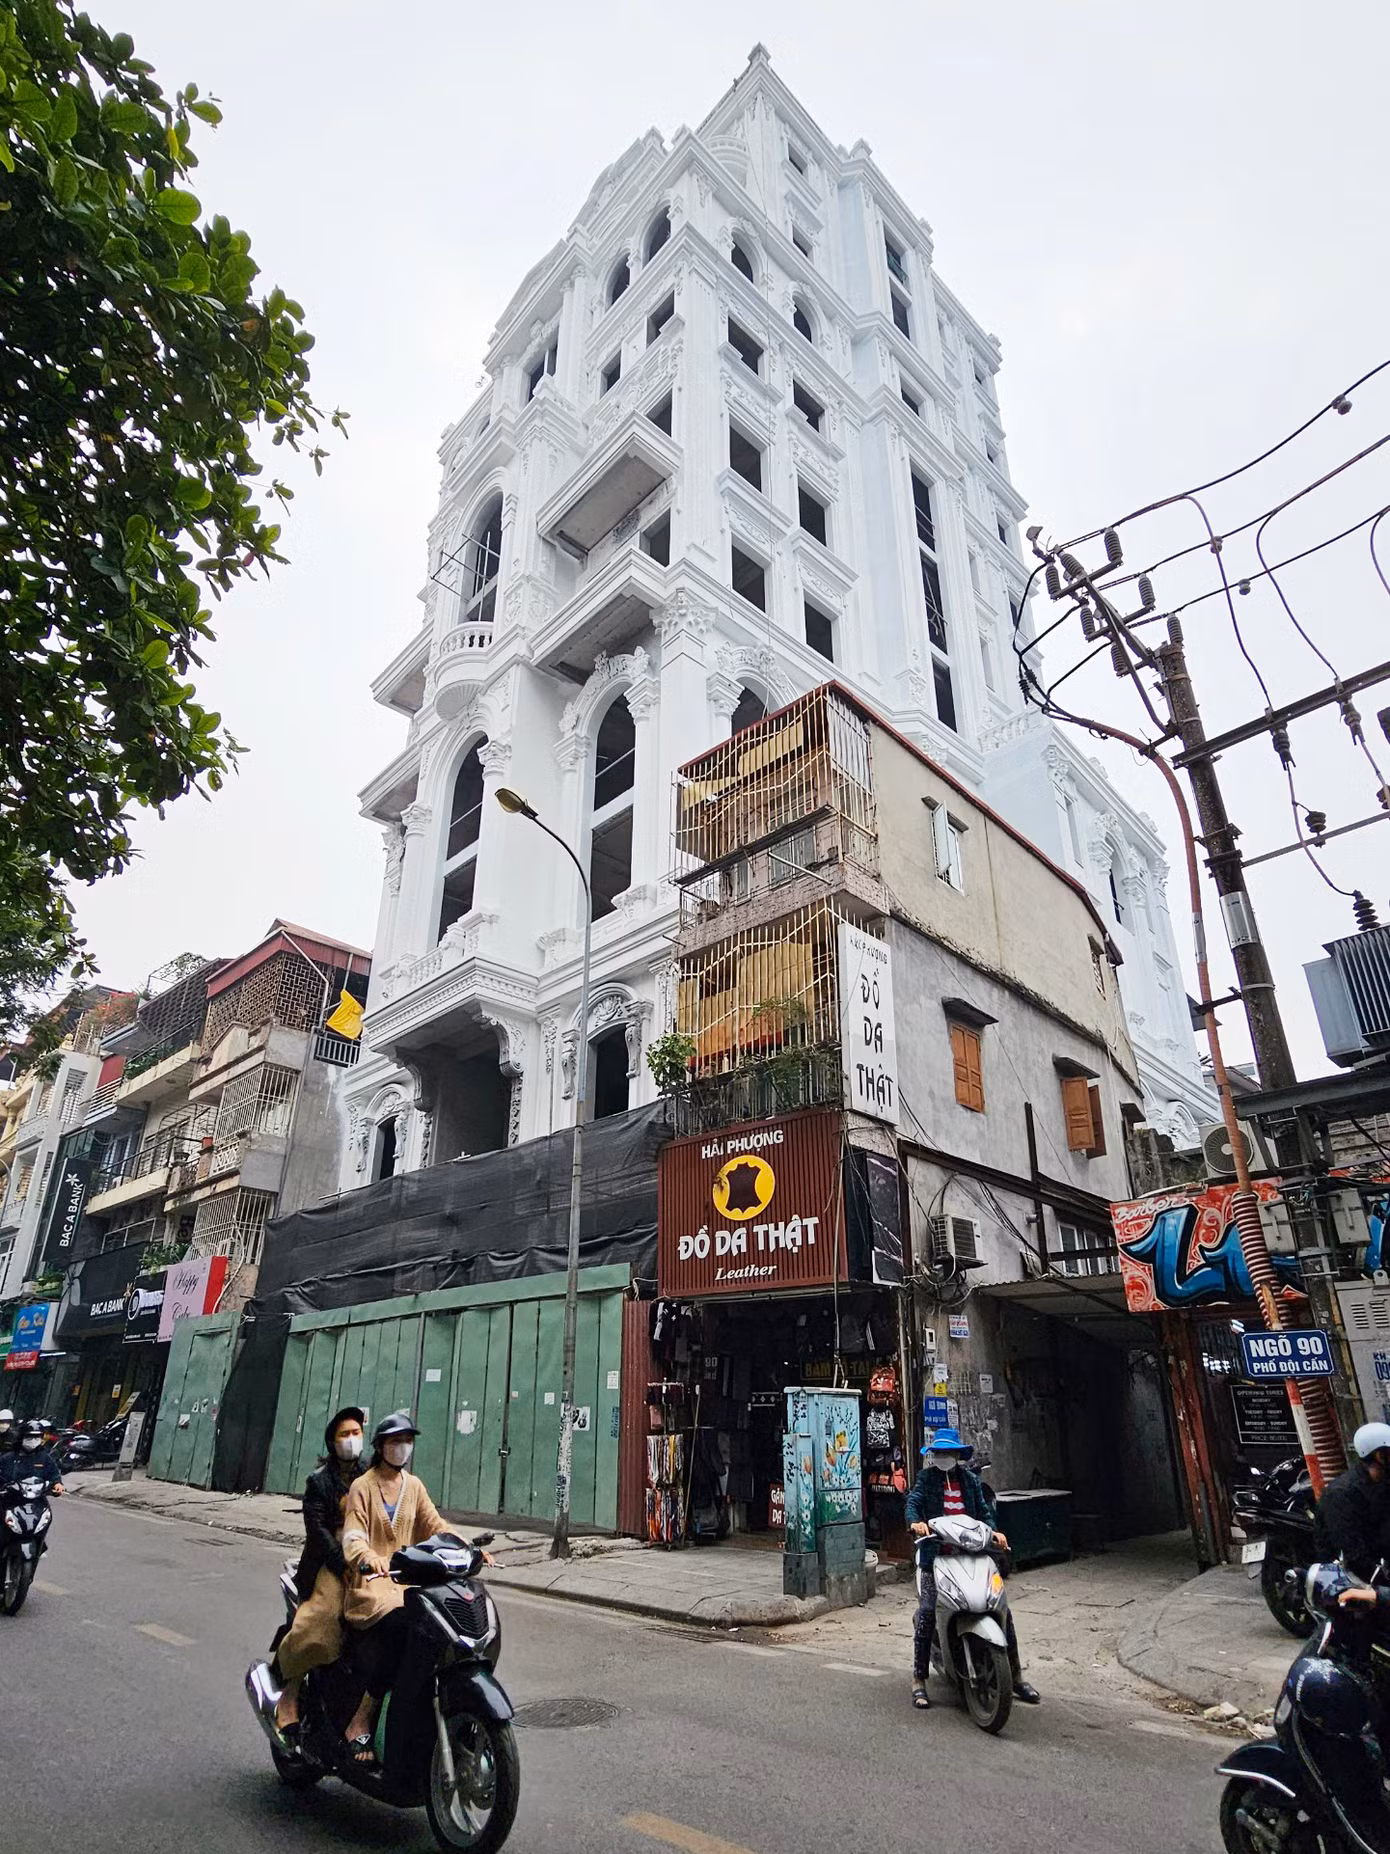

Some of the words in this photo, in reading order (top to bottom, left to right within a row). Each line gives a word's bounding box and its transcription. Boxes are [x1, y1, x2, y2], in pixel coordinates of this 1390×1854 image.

[860, 967, 880, 1010] ĐỒ
[863, 1015, 883, 1054] DA
[856, 1062, 894, 1113] THẬT
[701, 1138, 724, 1159] HẢI
[727, 1129, 784, 1154] PHƯỢNG
[67, 1183, 84, 1213] BANK
[65, 1214, 76, 1224] A
[59, 1223, 73, 1247] BAC
[677, 1224, 711, 1261] ĐỒ
[715, 1227, 748, 1257] DA
[753, 1214, 820, 1254] THẬT
[715, 1264, 777, 1281] Leather
[90, 1300, 104, 1316] BAC
[107, 1298, 125, 1313] BANK
[1248, 1334, 1292, 1358] NGÕ
[1296, 1336, 1324, 1356] 90
[1253, 1357, 1277, 1373] PHỐ
[1279, 1358, 1300, 1374] ĐỘI
[1302, 1356, 1329, 1372] CẤN
[1375, 1361, 1390, 1381] 09
